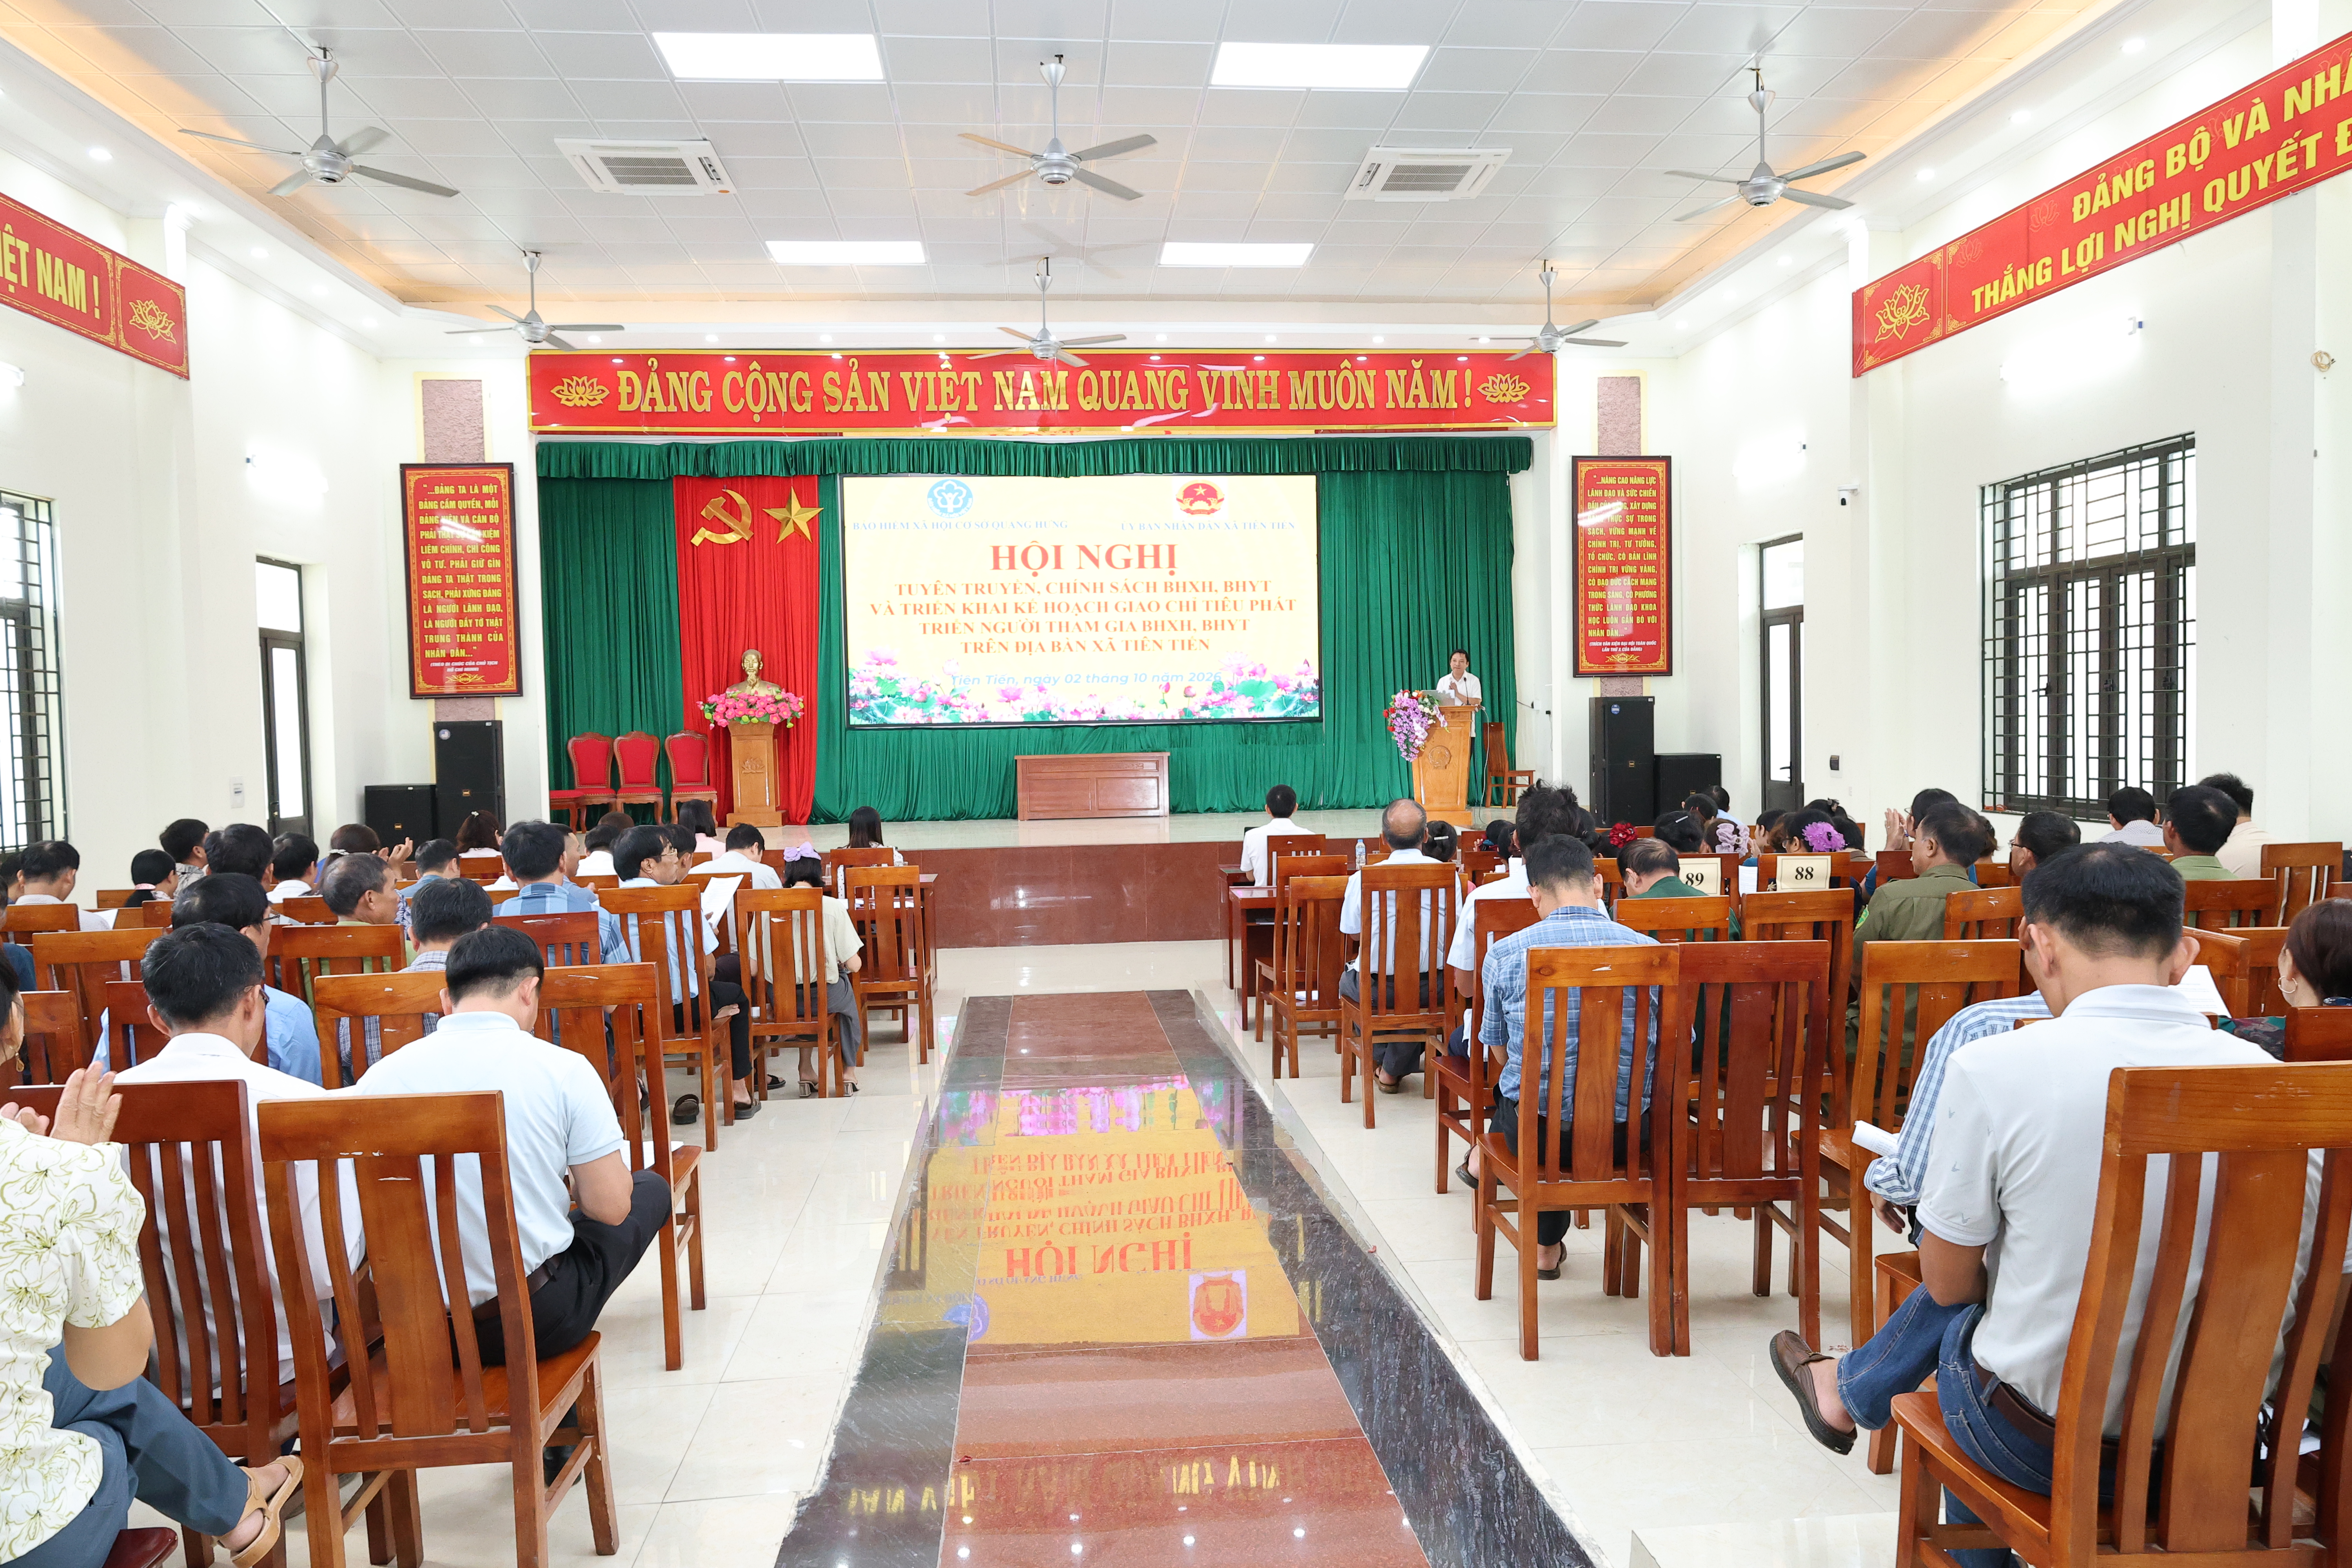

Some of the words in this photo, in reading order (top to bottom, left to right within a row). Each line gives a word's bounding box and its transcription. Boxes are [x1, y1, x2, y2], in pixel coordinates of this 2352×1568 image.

[2072, 172, 2155, 223] ĐẢNG
[2166, 126, 2211, 179] BỘ
[2222, 96, 2270, 150] VÀ
[1971, 263, 2052, 314] THẮNG
[2061, 231, 2104, 274] LỢI
[2114, 191, 2192, 253] NGHỊ
[2203, 129, 2323, 213] QUYẾT
[0, 223, 29, 293] ỆT
[36, 248, 87, 314] NAM
[616, 358, 712, 412] ĐẢNG
[722, 361, 813, 422] CỘNG
[823, 358, 890, 412] SẢN
[900, 359, 982, 422] VIỆT
[993, 371, 1069, 411] NAM
[1078, 369, 1188, 410] QUANG
[1197, 369, 1280, 411] VINH
[1288, 358, 1376, 410] MUÔN
[1630, 475, 1644, 484] NĂNG
[1646, 476, 1656, 486] LỰC
[470, 484, 479, 493] LÀ
[482, 483, 498, 495] MỘT
[1588, 488, 1602, 497] LÃNH
[1604, 490, 1615, 498] ĐẠO
[1617, 488, 1624, 497] VÀ
[1626, 488, 1637, 497] SỨC
[1639, 488, 1656, 497] CHIẾN
[419, 499, 438, 509] ĐẢNG
[485, 497, 498, 508] MỖI
[913, 520, 928, 529] XÃ
[932, 521, 952, 531] HỘI
[955, 521, 971, 529] CƠ
[992, 521, 1031, 530] QUANG
[1035, 520, 1067, 528] HƯNG
[1164, 521, 1194, 530] NHÂN
[1198, 520, 1220, 530] DÂN
[1224, 521, 1238, 530] XÃ
[1241, 520, 1266, 530] TIÊN
[421, 544, 438, 554] LIÊM
[466, 543, 479, 553] CHÍ
[481, 543, 500, 553] CÔNG
[1588, 539, 1606, 548] CHÍNH
[1610, 541, 1621, 549] TRỊ,
[1635, 538, 1656, 548] TƯỞNG,
[421, 559, 431, 568] VÔ
[450, 557, 467, 568] PHẢI
[471, 558, 485, 568] GIỮ
[488, 558, 501, 568] GÌN
[989, 540, 1065, 577] HỘI
[1075, 544, 1178, 576] NGHỊ
[1588, 565, 1606, 573] CHÍNH
[1609, 566, 1618, 574] TRỊ
[1621, 564, 1637, 573] VỮNG
[1640, 564, 1657, 573] VÀNG,
[422, 573, 442, 584] ĐẢNG
[457, 573, 474, 584] THẬT
[477, 574, 501, 583] TRONG
[1588, 577, 1595, 586] CÓ
[1597, 579, 1609, 587] ĐẠO
[1610, 577, 1621, 586] ĐỨC
[1623, 576, 1638, 585] CÁCH
[1640, 578, 1657, 587] MẠNG
[895, 580, 956, 595] TUYÊN
[962, 579, 1040, 595] TRUYỀN,
[1046, 579, 1103, 593] CHÍNH
[1111, 579, 1157, 593] SÁCH
[1164, 581, 1218, 593] BHXH,
[1224, 581, 1271, 592] BHYT
[423, 590, 443, 600] SẠCH,
[445, 587, 461, 598] PHẢI
[463, 588, 481, 597] XỨNG
[483, 588, 501, 597] ĐÁNG
[1608, 590, 1624, 599] SÁNG,
[1626, 590, 1633, 598] CÓ
[423, 604, 432, 613] LÀ
[437, 603, 459, 613] NGƯỜI
[463, 603, 482, 612] LÃNH
[486, 604, 503, 613] ĐẠO,
[870, 601, 895, 615] VÀ
[900, 601, 955, 615] TRIỂN
[962, 603, 1007, 614] KHAI
[1014, 599, 1038, 613] KẾ
[1045, 602, 1108, 616] HOẠCH
[1115, 601, 1160, 612] GIAO
[1166, 597, 1196, 612] CHỈ
[1202, 597, 1243, 611] TIÊU
[1250, 596, 1296, 611] PHÁT
[1588, 603, 1603, 611] THỨC
[1607, 603, 1622, 611] LÃNH
[1625, 604, 1637, 613] ĐẠO
[424, 619, 433, 628] LÀ
[435, 618, 457, 628] NGƯỜI
[475, 617, 483, 627] TỚ
[485, 617, 503, 628] THẬT
[1588, 617, 1600, 625] HỌC
[1603, 615, 1618, 624] LUÔN
[1637, 615, 1644, 623] BÓ
[1648, 615, 1657, 623] VỚI
[919, 619, 974, 634] TRIỂN
[981, 619, 1040, 633] NGƯỜI
[1046, 621, 1098, 632] THAM
[1105, 621, 1137, 632] GIA
[1143, 620, 1196, 632] BHXH,
[1203, 619, 1249, 631] BHYT
[425, 634, 451, 643] TRUNG
[456, 633, 482, 642] THÀNH
[488, 631, 503, 641] CỦA
[961, 638, 1008, 653] TRÊN
[1015, 641, 1045, 655] ĐỊA
[1052, 638, 1085, 652] BÀN
[1093, 637, 1116, 652] XÃ
[1122, 636, 1163, 651] TIÊN
[1169, 636, 1209, 650] TIẾN
[986, 675, 1018, 685] Tiến,
[1024, 675, 1060, 686] ngày
[1065, 674, 1081, 683] 02
[1086, 674, 1128, 684] tháng
[1134, 673, 1147, 682] 10
[1152, 673, 1183, 682] năm
[1686, 873, 1704, 886] 89
[1795, 867, 1813, 880] 88
